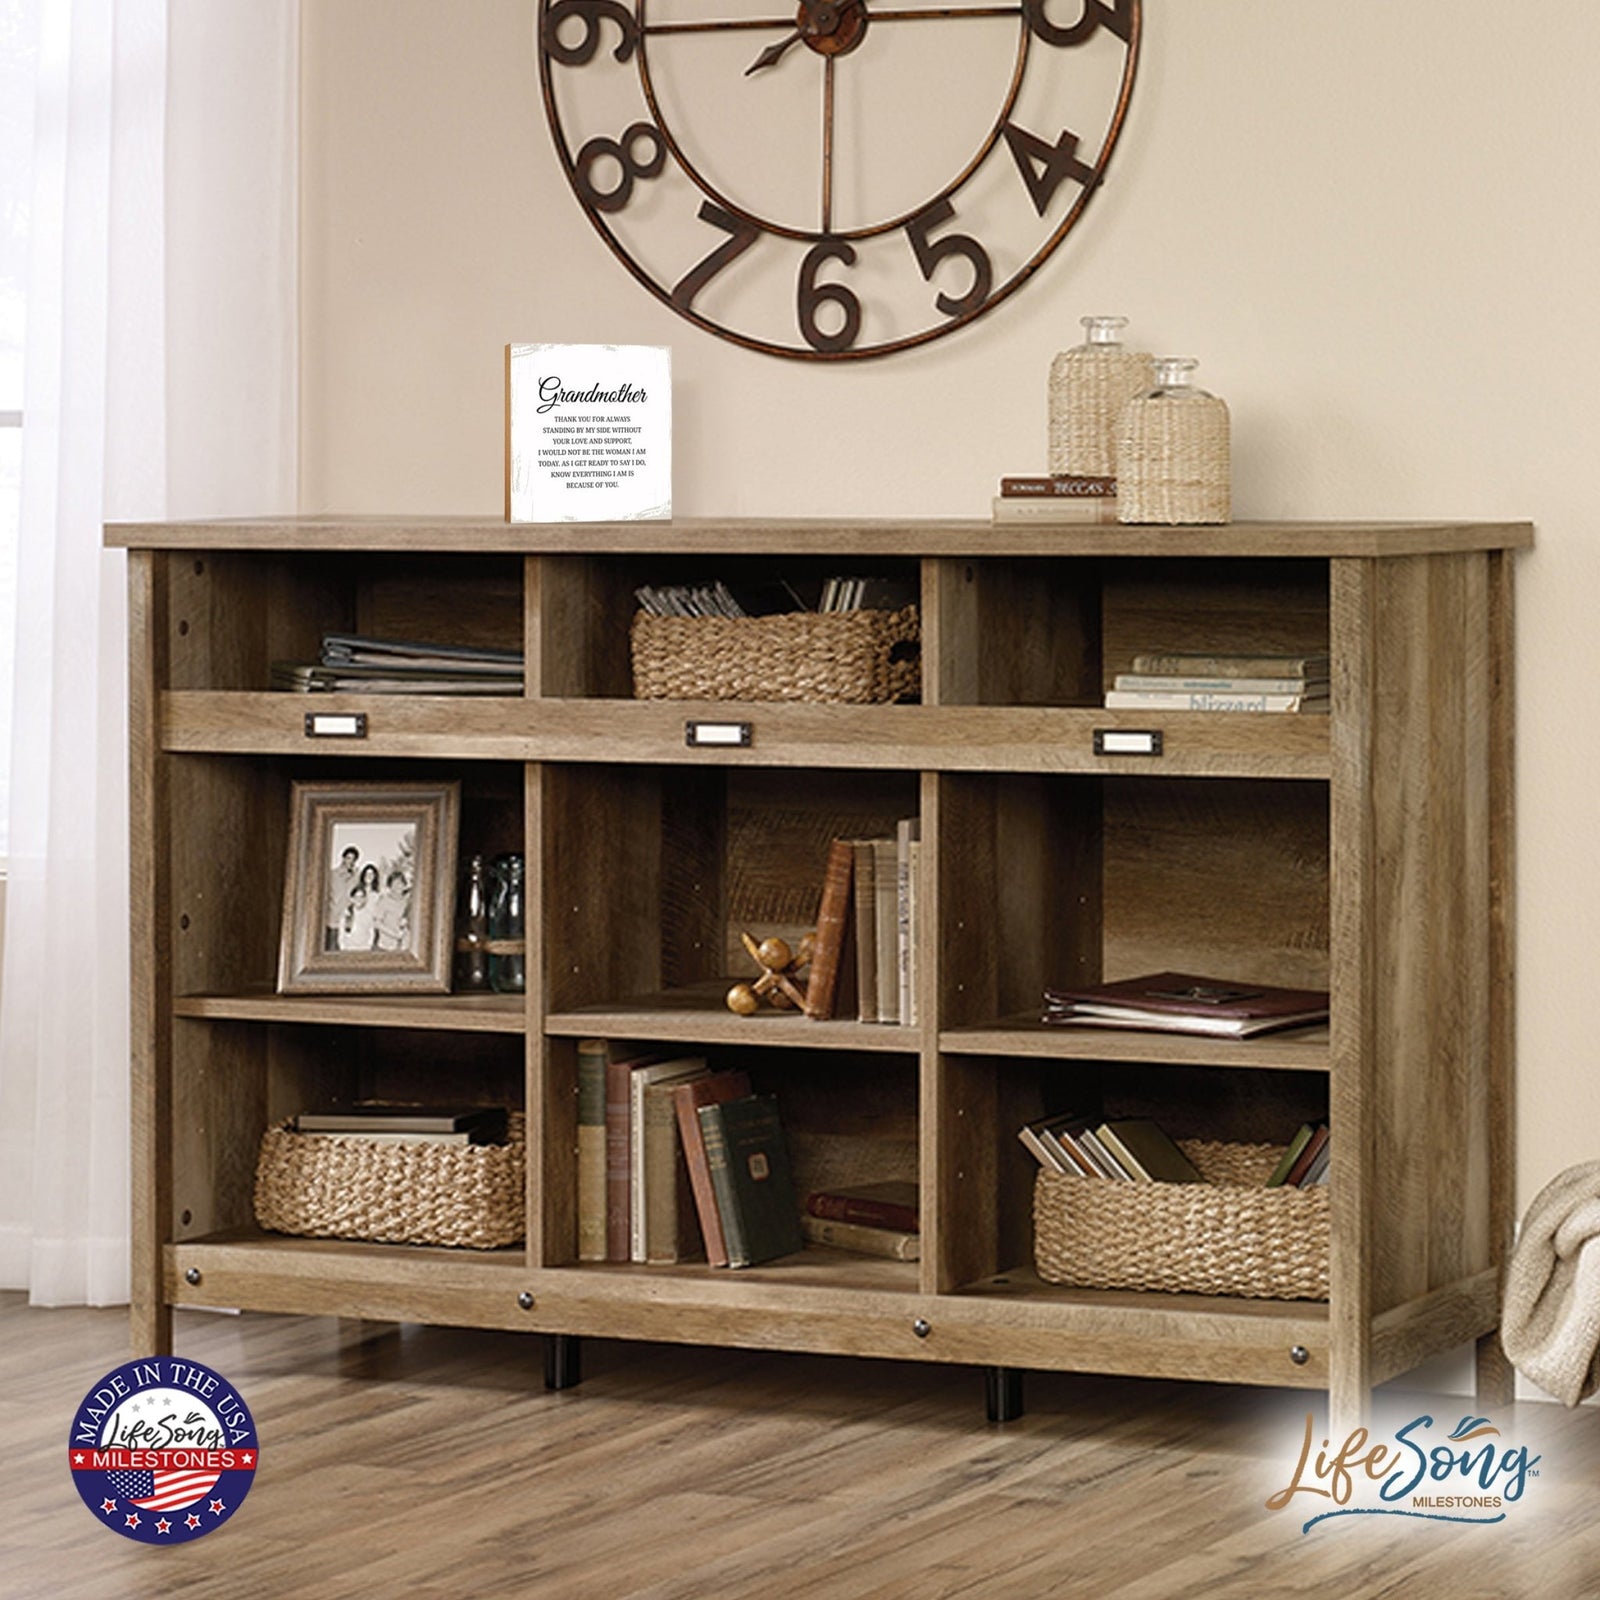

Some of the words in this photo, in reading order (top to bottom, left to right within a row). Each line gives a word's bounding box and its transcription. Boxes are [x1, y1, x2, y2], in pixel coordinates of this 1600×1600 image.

[574, 122, 668, 212] 8
[1003, 119, 1104, 218] 4
[670, 200, 761, 311] 7
[797, 241, 862, 353] 6
[902, 199, 993, 318] 5
[536, 376, 648, 414] Grandmother
